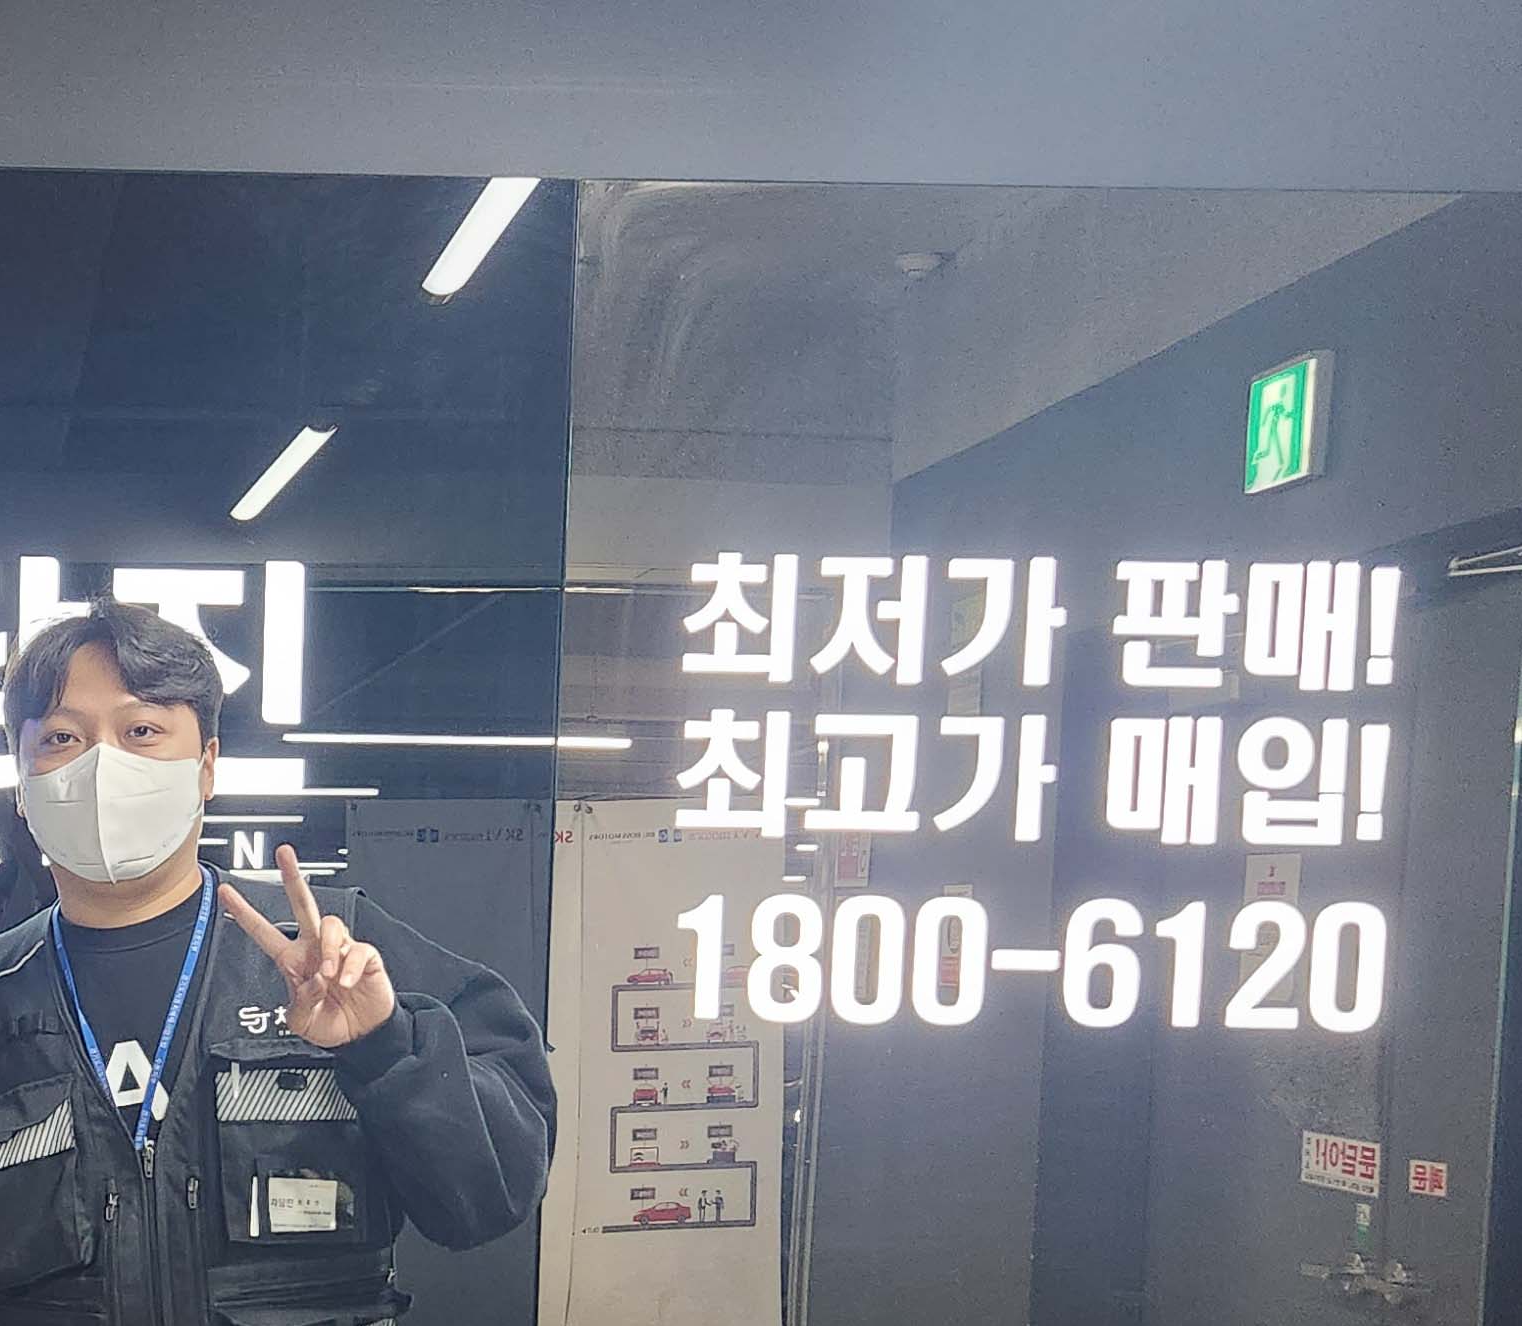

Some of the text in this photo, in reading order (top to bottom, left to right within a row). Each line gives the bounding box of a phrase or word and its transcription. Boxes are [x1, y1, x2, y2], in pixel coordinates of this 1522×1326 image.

[681, 552, 1402, 692] 최저가 판매!
[675, 708, 1391, 846] 최고가 매입!
[677, 893, 1389, 1033] 1800-6120
